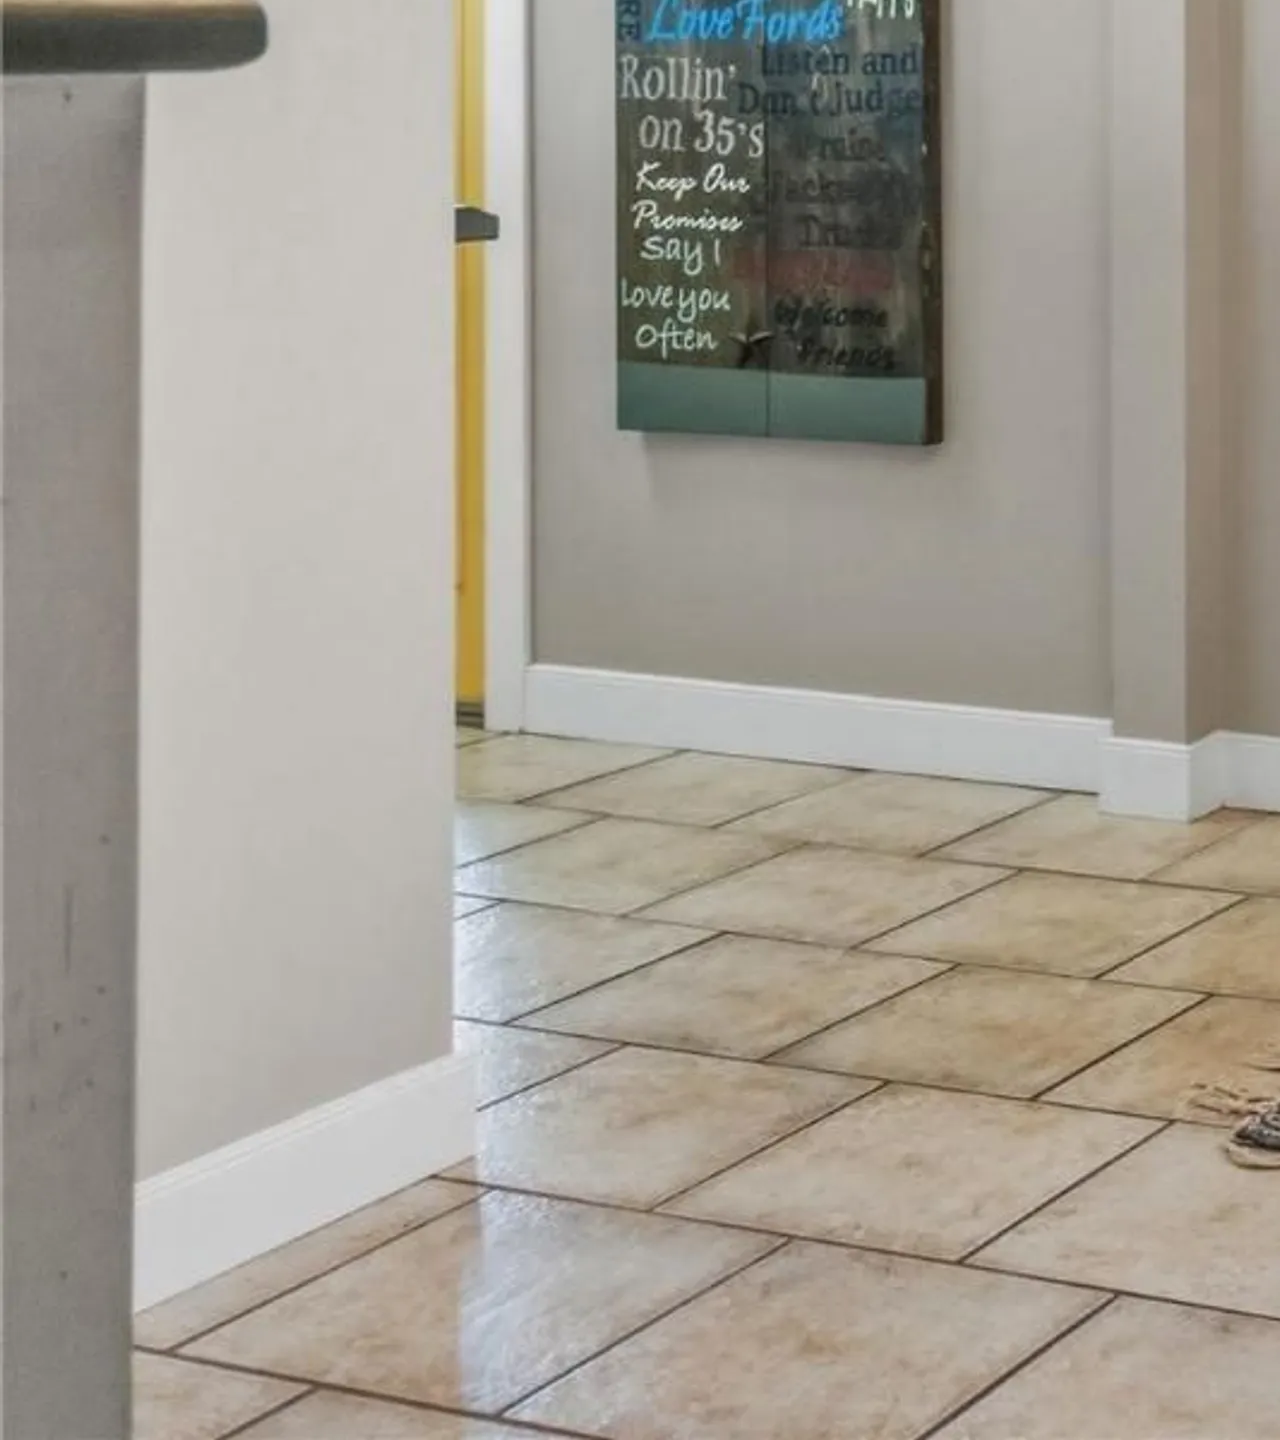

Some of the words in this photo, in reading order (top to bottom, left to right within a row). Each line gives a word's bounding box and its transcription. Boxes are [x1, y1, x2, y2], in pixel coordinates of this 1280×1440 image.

[620, 53, 736, 102] Rollin'
[861, 43, 920, 76] and
[639, 114, 687, 151] on
[636, 160, 697, 202] Keep
[702, 162, 751, 194] Our
[630, 198, 744, 232] Promises
[676, 286, 732, 323] you
[634, 315, 720, 360] Often
